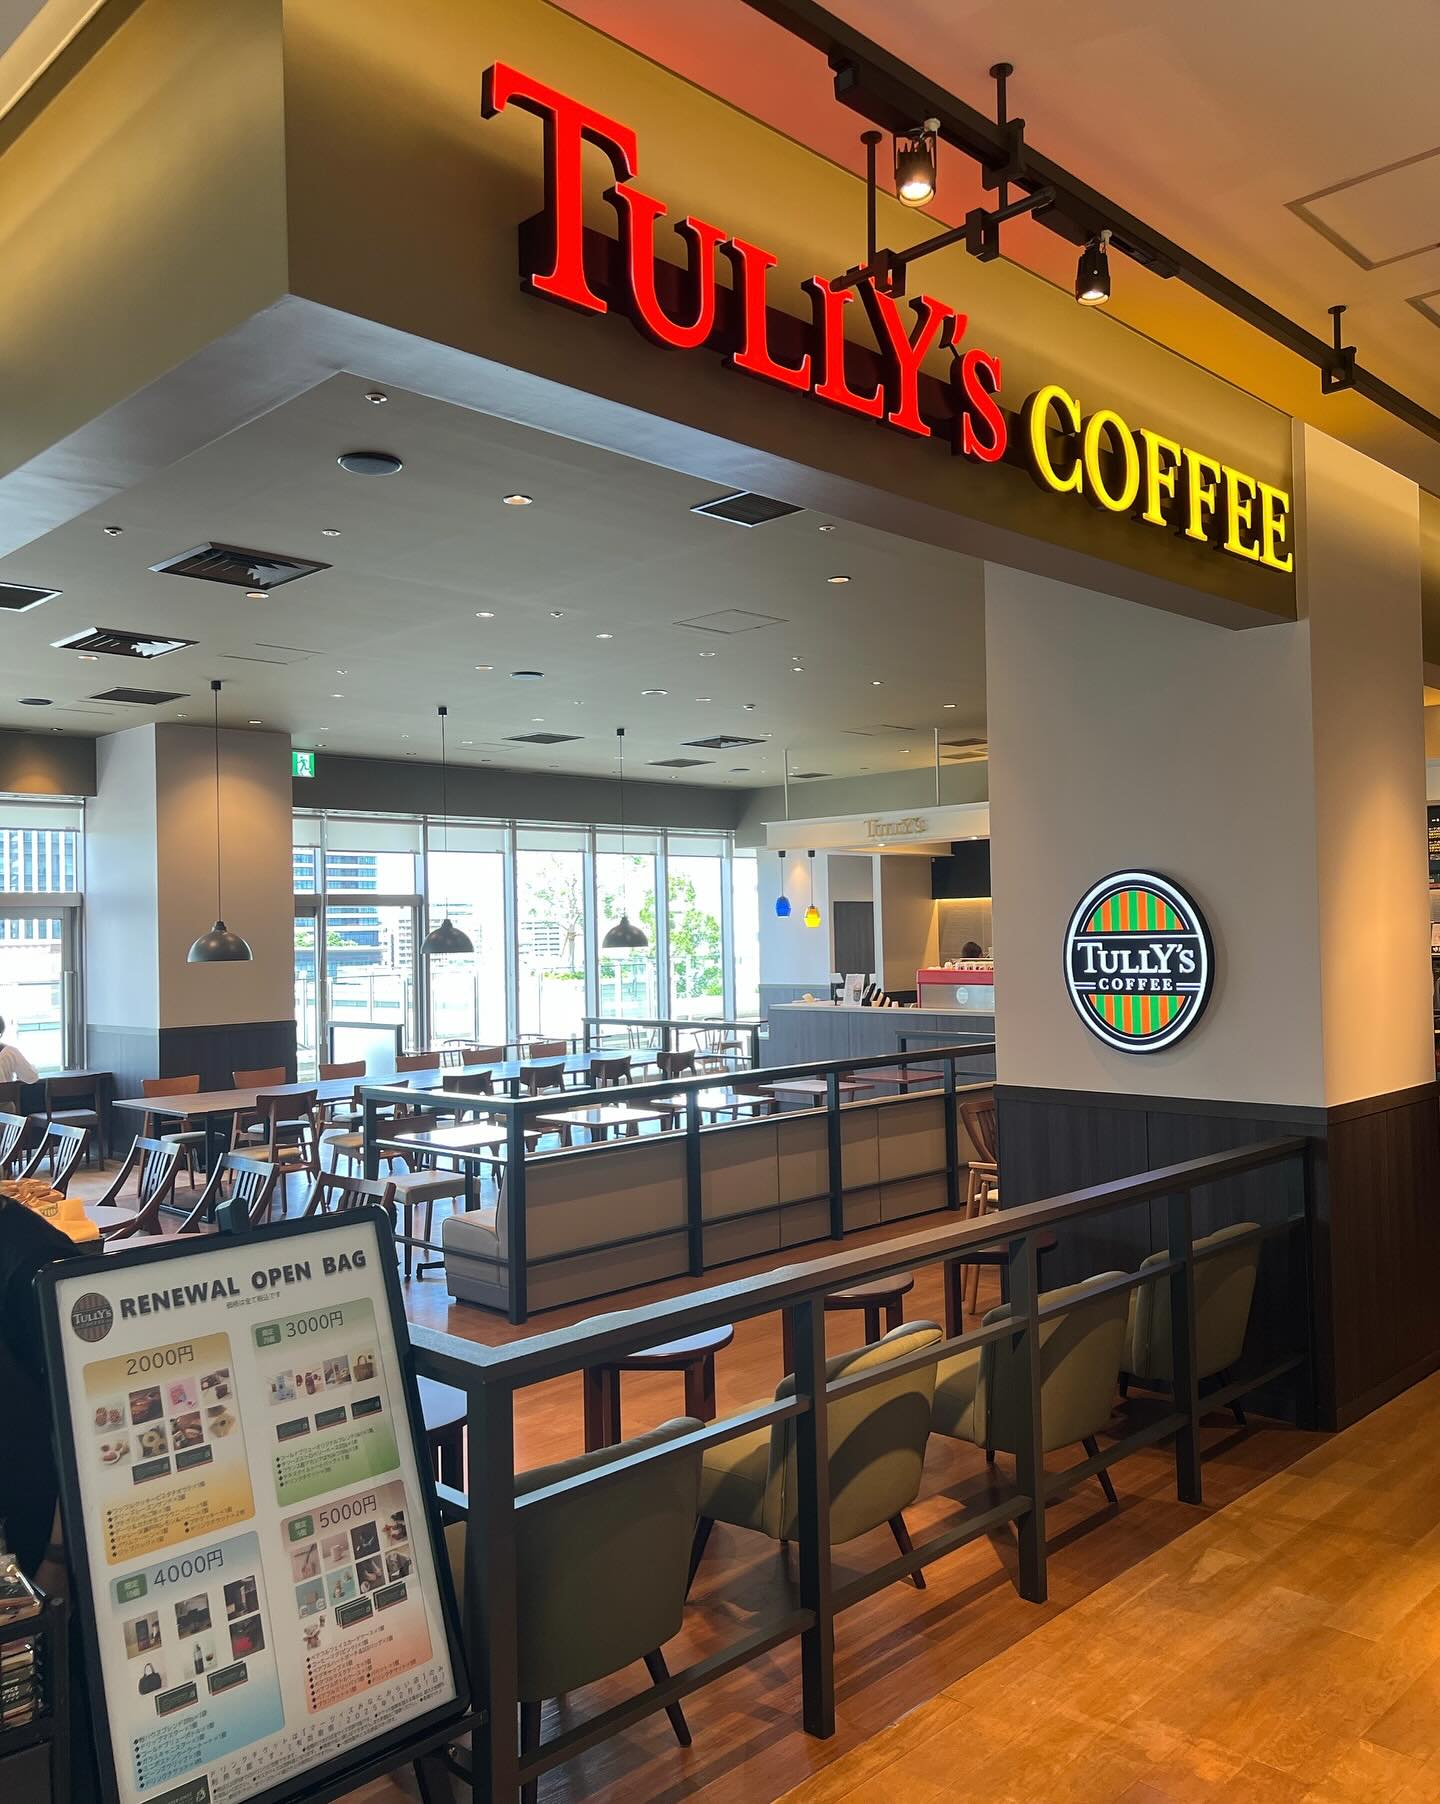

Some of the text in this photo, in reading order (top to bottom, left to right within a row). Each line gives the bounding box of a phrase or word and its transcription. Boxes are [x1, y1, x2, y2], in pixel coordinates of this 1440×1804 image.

[481, 62, 1294, 575] TULLY'S COFFEE
[1077, 942, 1196, 974] TULLY'S
[1098, 978, 1173, 991] COFFEE
[120, 1250, 367, 1319] RENEWAL OPEN BAG
[286, 1310, 344, 1338] 3000円
[126, 1344, 194, 1376] 2000円
[319, 1494, 377, 1528] 5000円
[153, 1549, 224, 1586] 4000円
